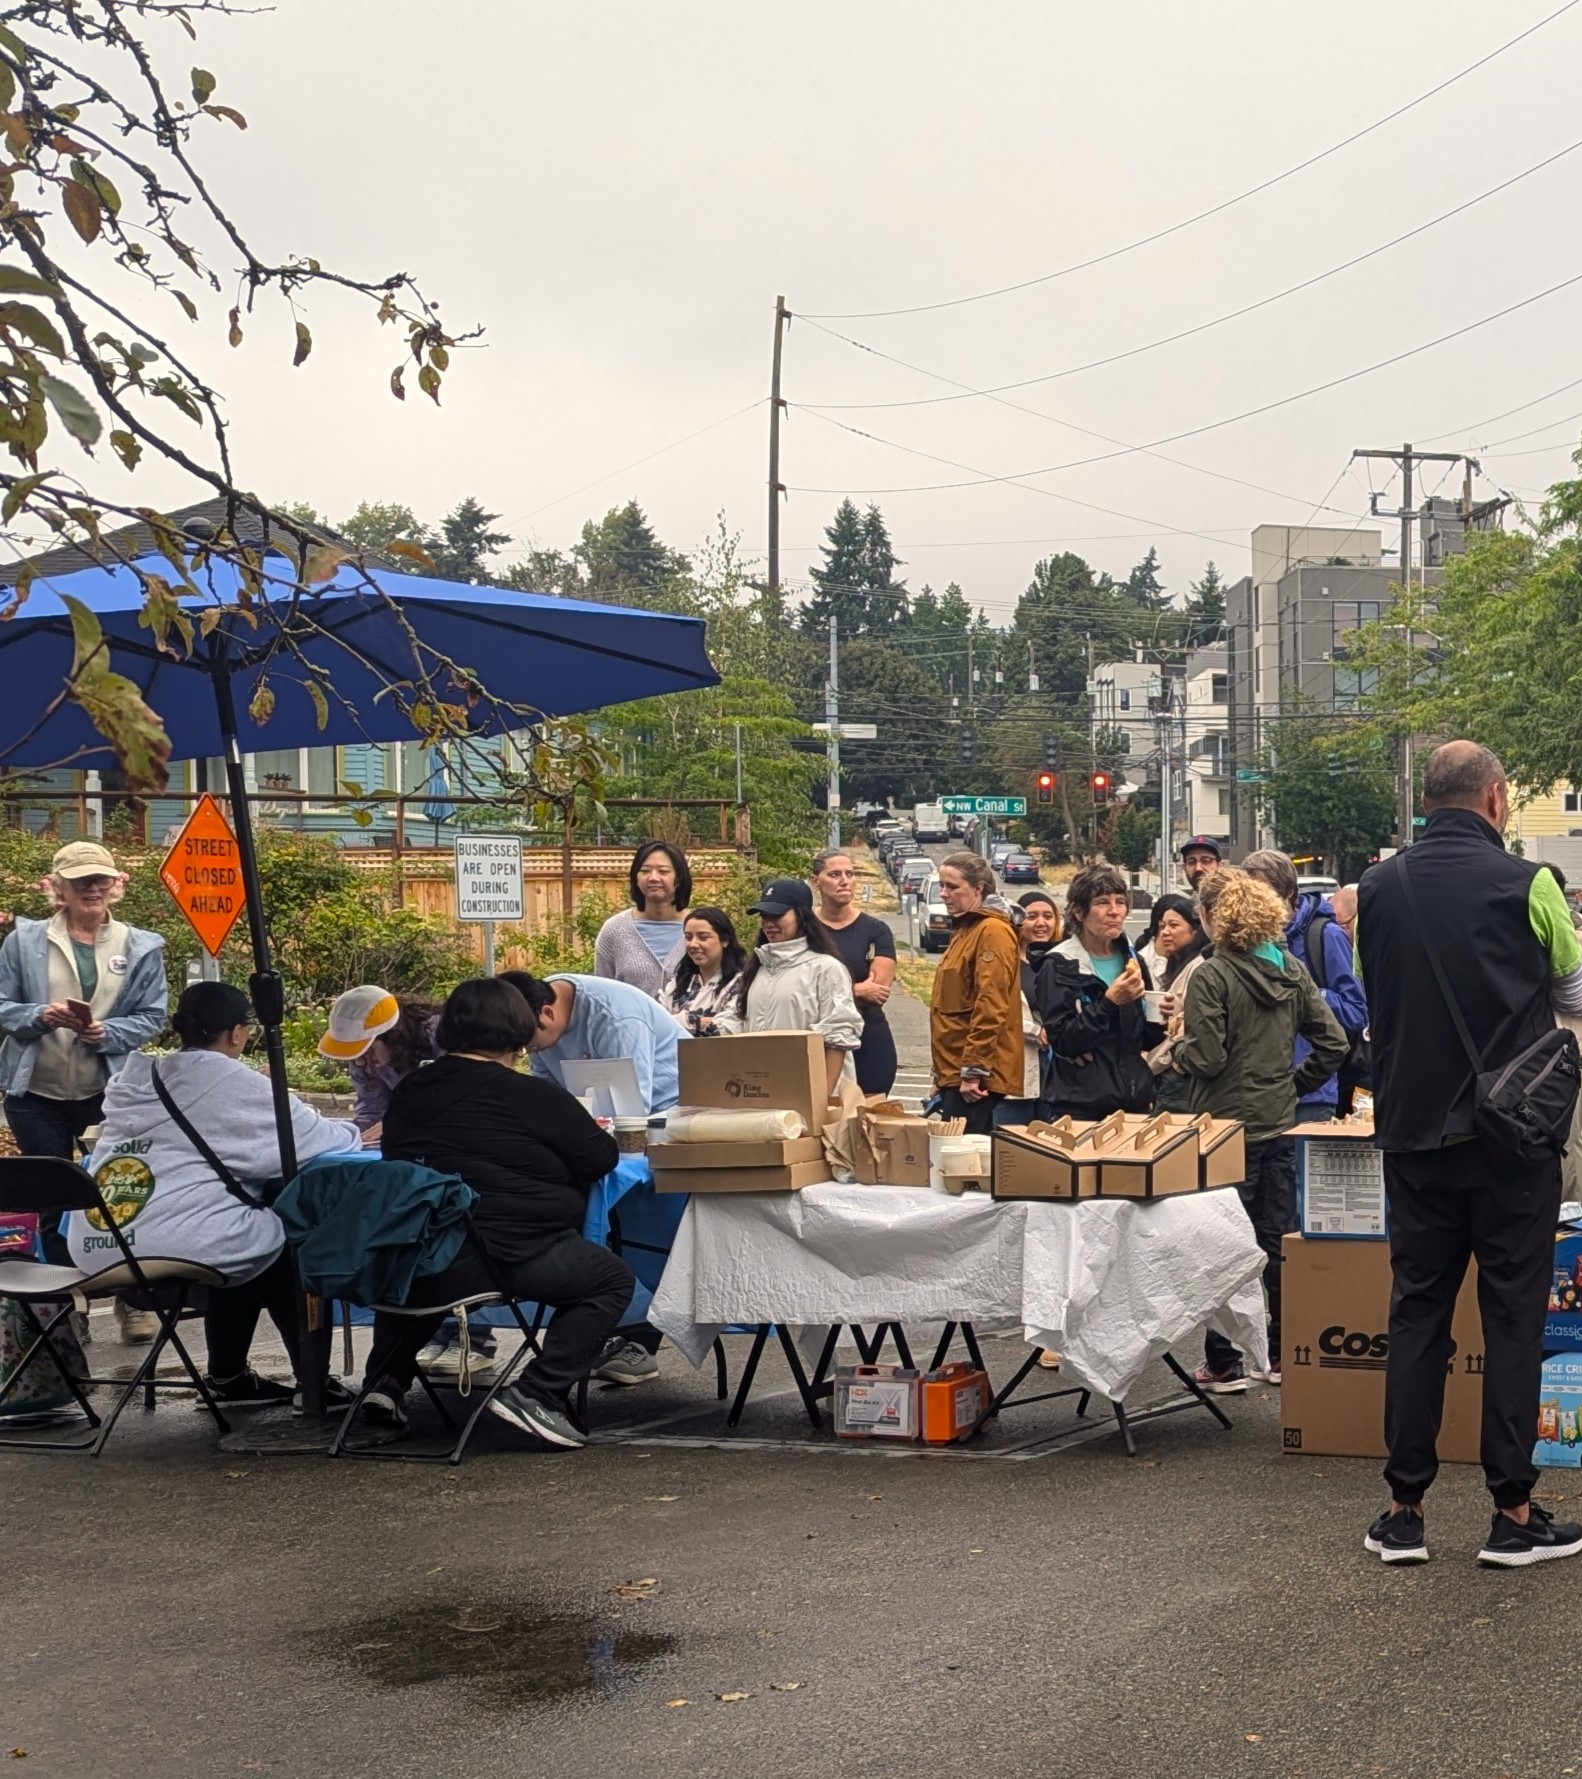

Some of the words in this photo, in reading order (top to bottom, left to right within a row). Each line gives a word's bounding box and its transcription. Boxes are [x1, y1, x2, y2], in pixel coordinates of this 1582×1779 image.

[956, 801, 972, 811] NW
[975, 798, 1008, 812] Canal
[1013, 802, 1024, 812] St
[185, 838, 233, 857] STREET
[458, 843, 519, 858] BUSINESSES
[184, 866, 236, 885] CLOSED
[463, 862, 483, 875] ARE
[490, 862, 517, 876] OPEN
[471, 881, 509, 894] DURING
[190, 896, 233, 914] AHEAD
[461, 899, 520, 913] CONSTRUCTION
[112, 1138, 154, 1154] solid
[1541, 1363, 1563, 1374] RICE
[1285, 1431, 1300, 1446] 50
